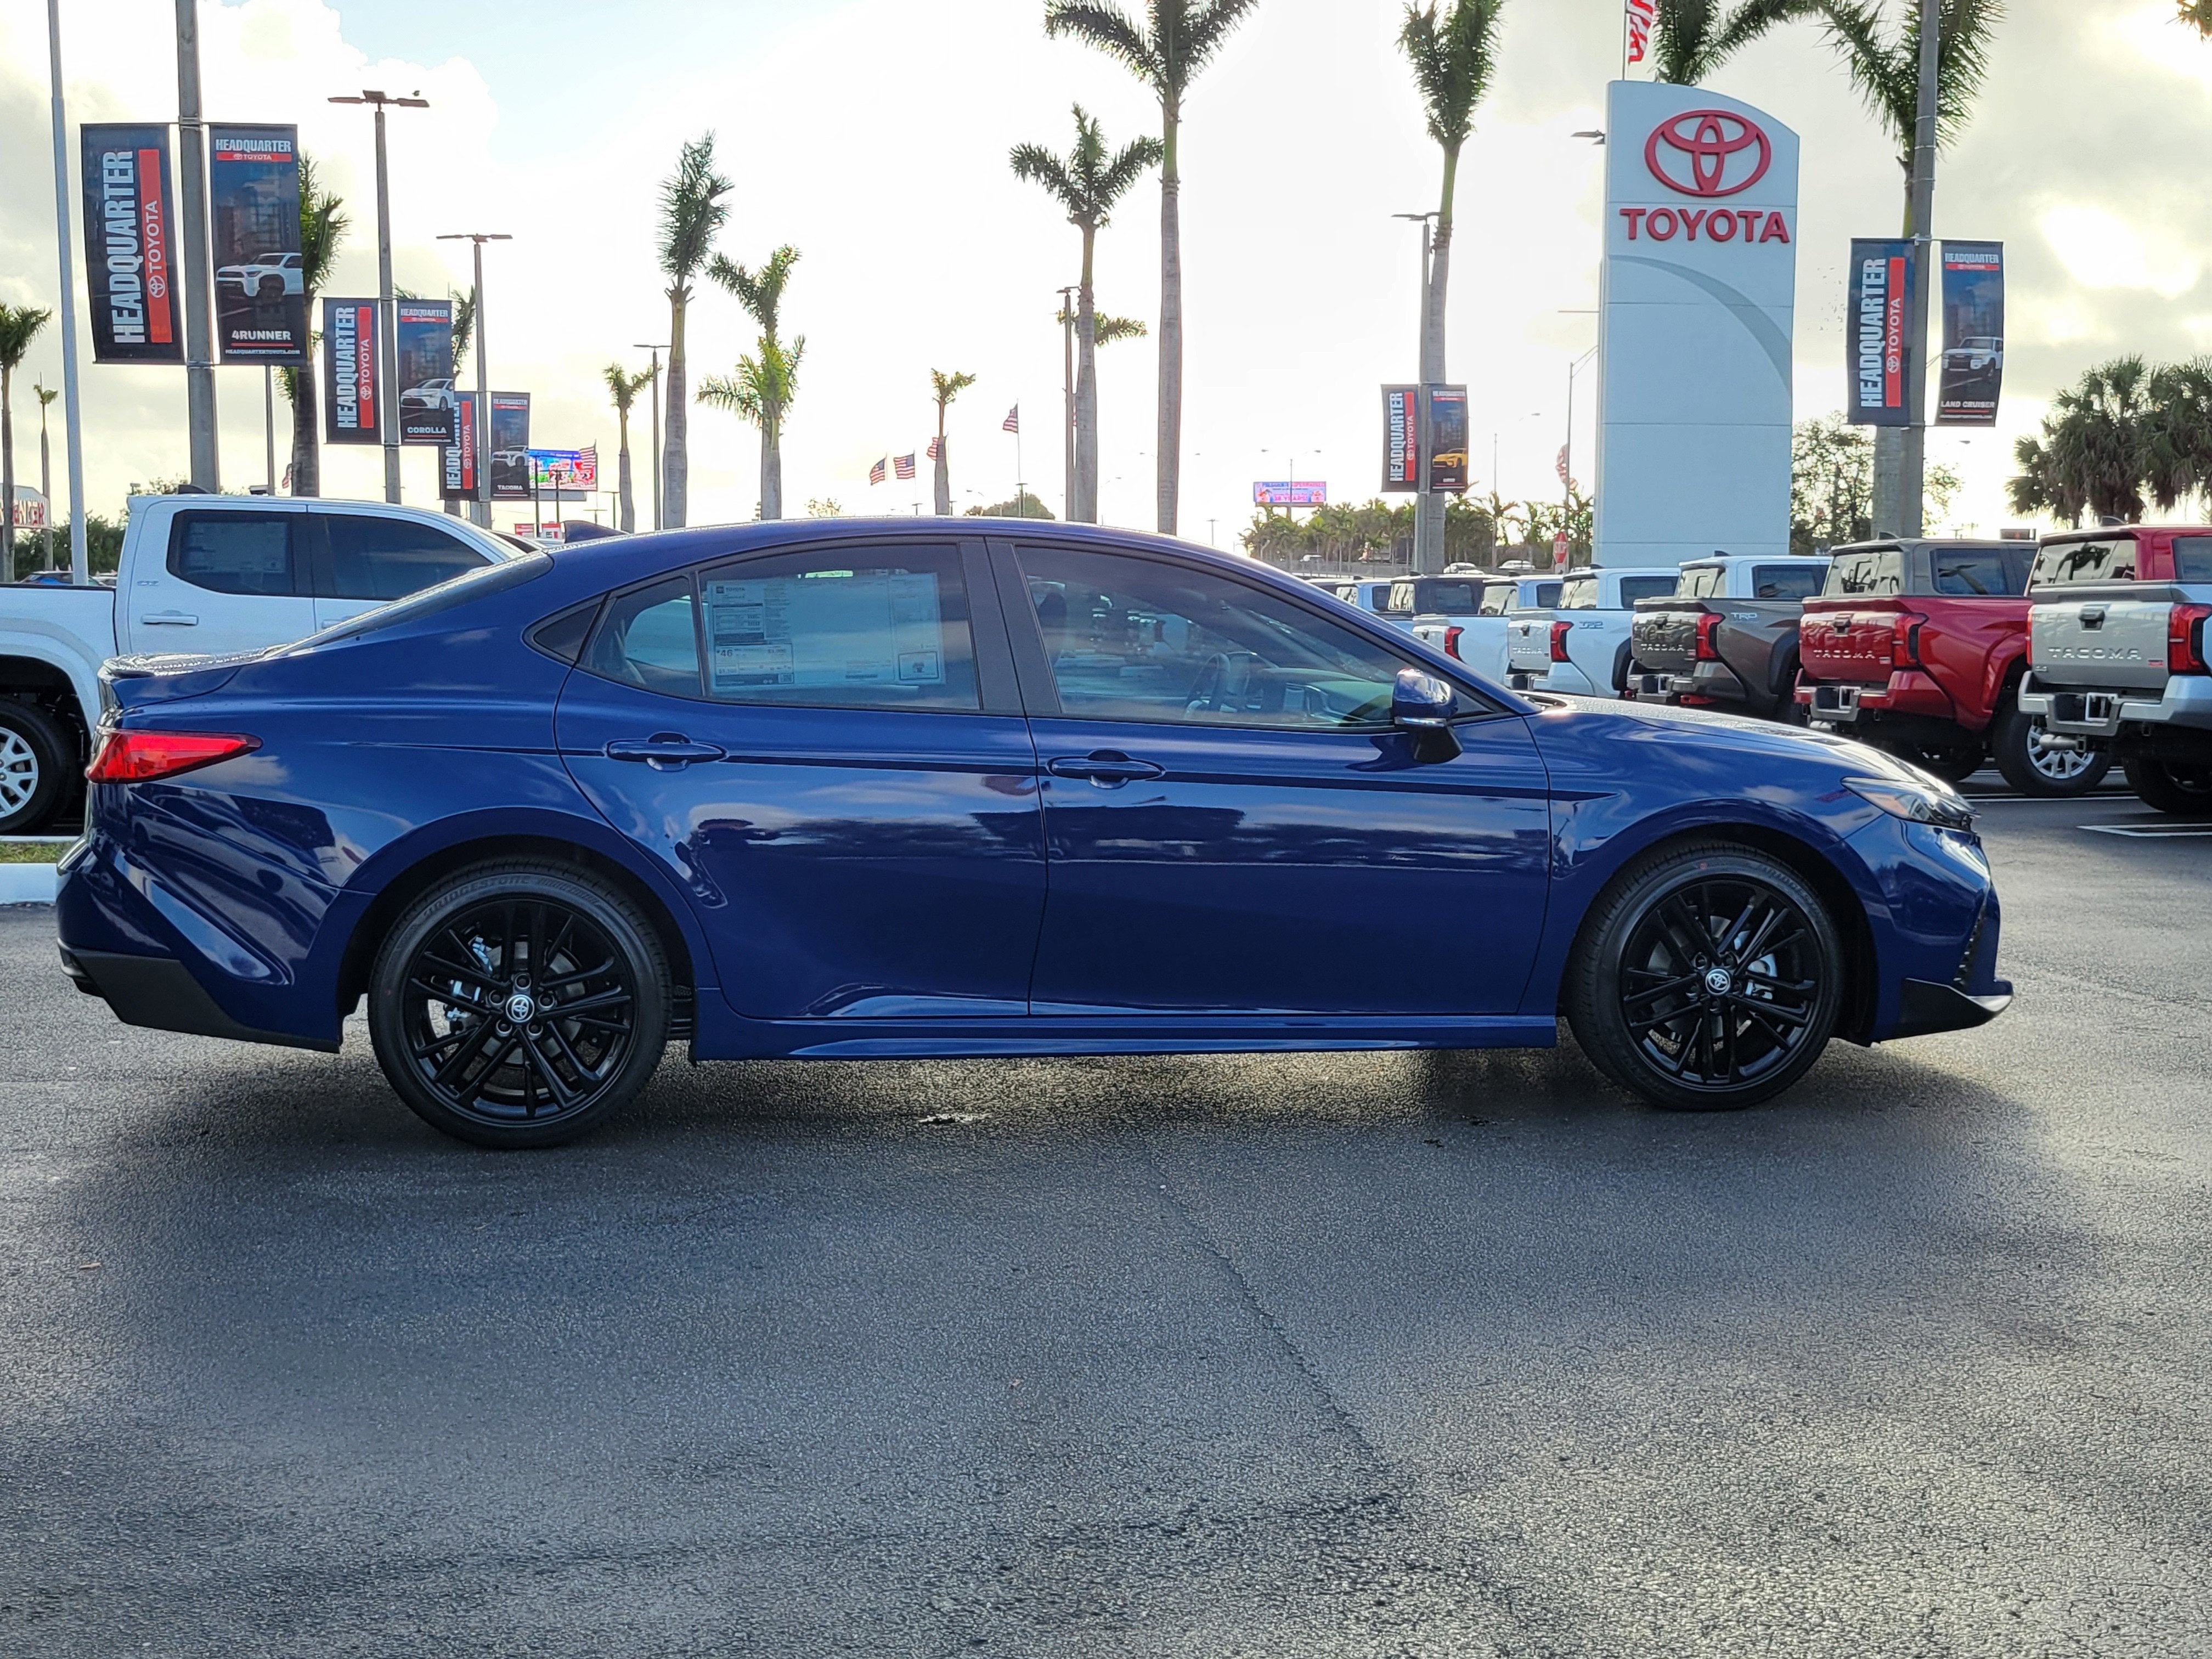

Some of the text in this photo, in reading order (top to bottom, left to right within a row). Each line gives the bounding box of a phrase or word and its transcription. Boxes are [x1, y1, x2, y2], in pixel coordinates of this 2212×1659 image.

[216, 139, 291, 153] HEADQUARTER
[145, 200, 162, 273] TOYOTA
[1620, 207, 1790, 244] TOYOTA
[103, 151, 145, 343] HEADQUARTER
[1945, 252, 1999, 263] HEADQUARTER
[401, 308, 448, 317] HEADQUARTER
[1888, 297, 1900, 354] TOYOTA
[232, 330, 291, 340] 4RUNNER
[1859, 258, 1886, 408] HEADQUARTER
[335, 307, 358, 428] HEADQUARTER
[361, 338, 370, 384] TOYOTA
[1389, 392, 1406, 481] HEADQUARTER
[720, 649, 733, 657] 46
[1813, 650, 1876, 659] TACOMA
[2048, 647, 2142, 660] TACOMA
